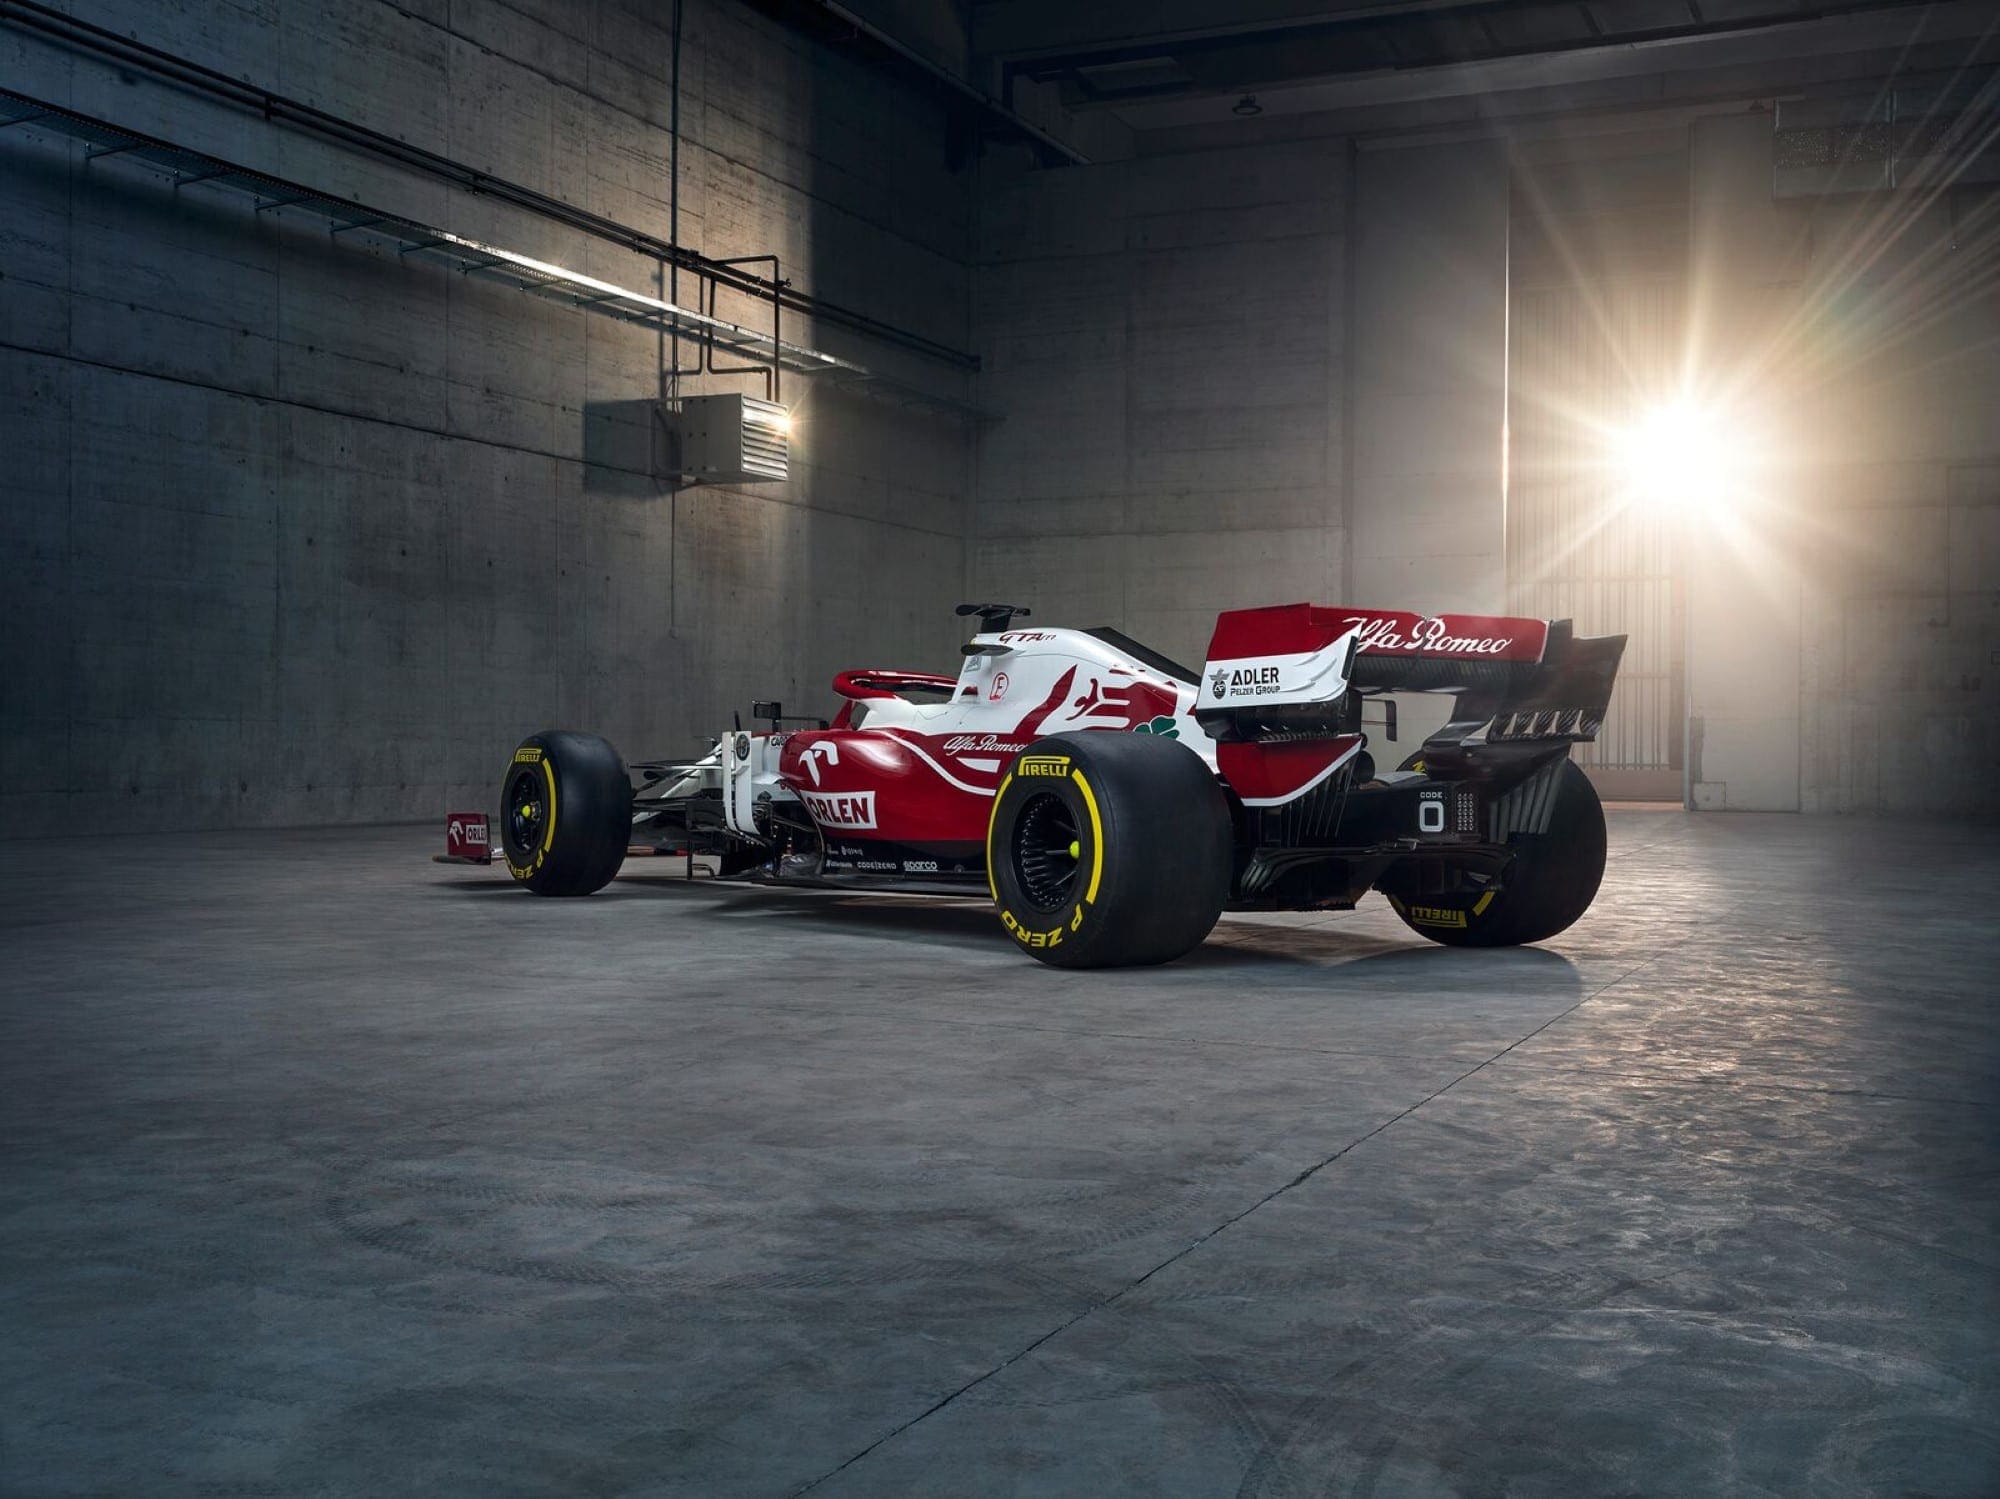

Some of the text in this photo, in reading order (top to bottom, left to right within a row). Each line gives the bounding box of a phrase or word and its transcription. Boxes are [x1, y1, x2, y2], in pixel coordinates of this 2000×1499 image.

[1405, 617, 1513, 654] Romeo
[1230, 667, 1280, 687] ADLER
[514, 748, 542, 763] PIRELLI
[943, 734, 1029, 756] Alfa Romeo
[1018, 756, 1071, 777] PIRELLI
[1420, 791, 1443, 799] CODE
[805, 797, 871, 825] ORLEN
[467, 827, 488, 841] ORLE
[903, 860, 938, 872] sparco
[1001, 904, 1084, 948] P ZERO
[1411, 905, 1468, 928] PIRELLI
